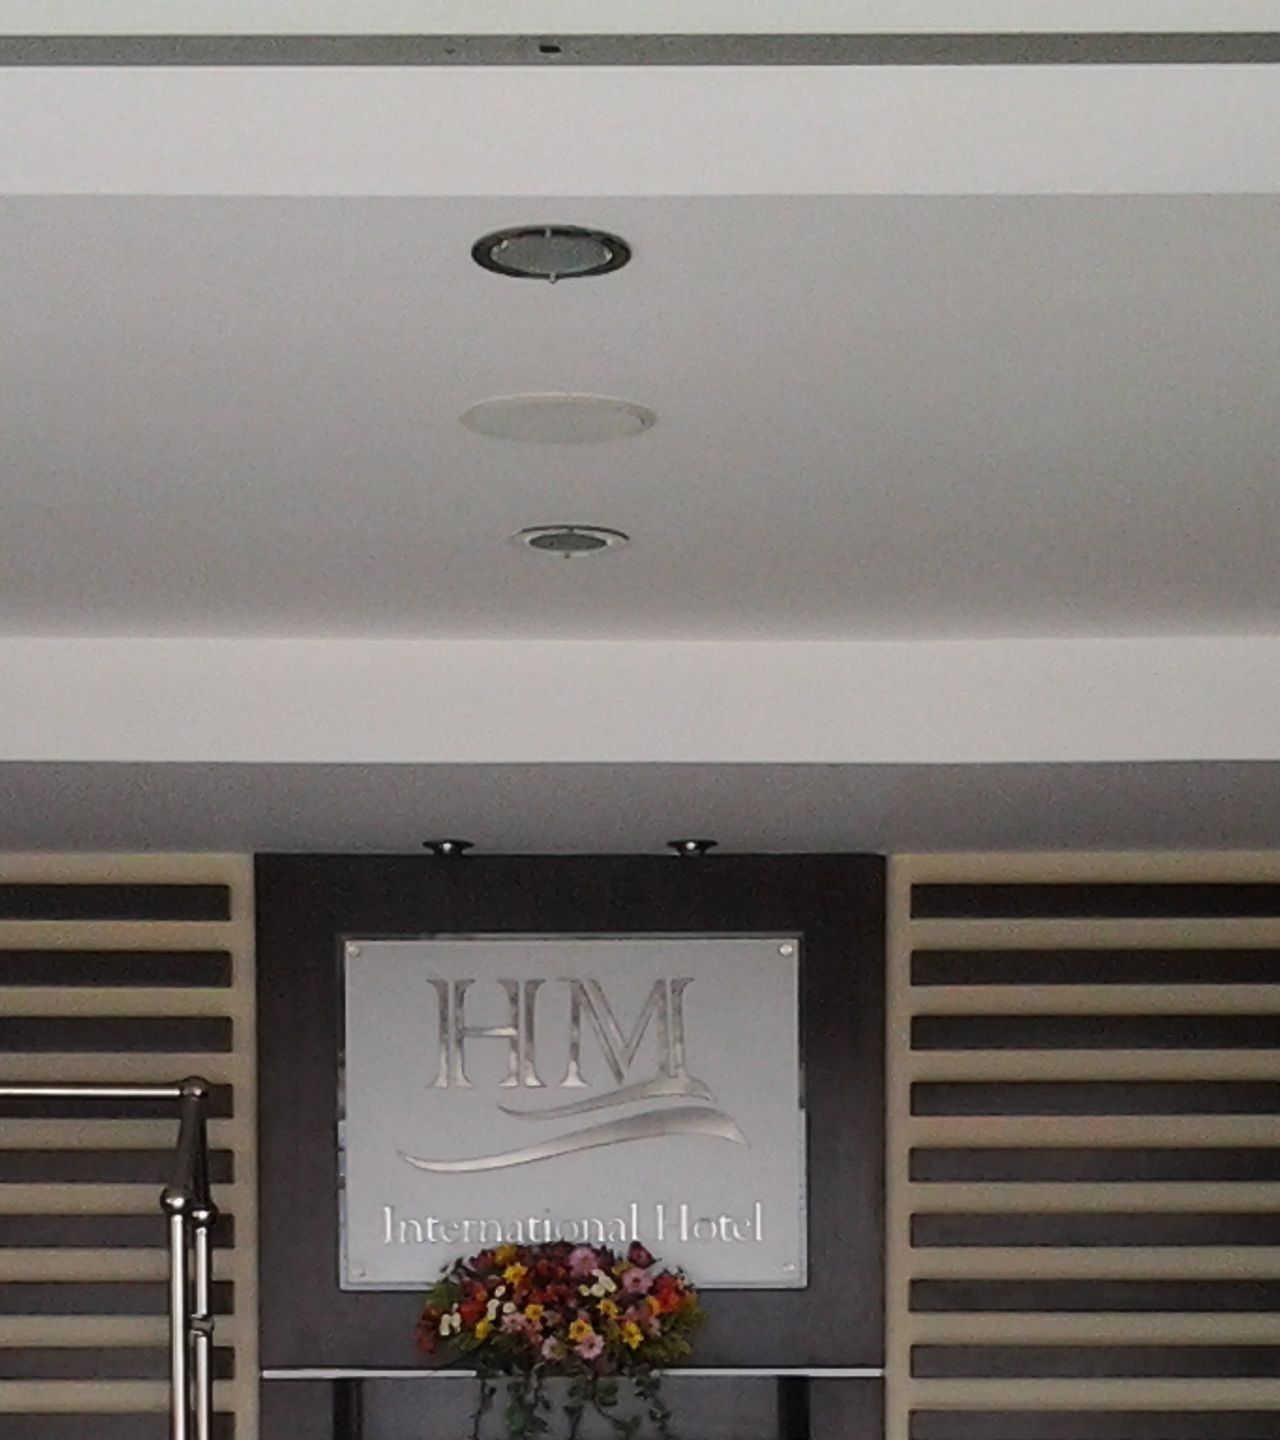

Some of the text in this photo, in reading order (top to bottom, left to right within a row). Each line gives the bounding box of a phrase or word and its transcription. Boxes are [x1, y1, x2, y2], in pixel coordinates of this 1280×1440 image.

[426, 977, 695, 1089] HM
[382, 1202, 763, 1244] International Hotel
